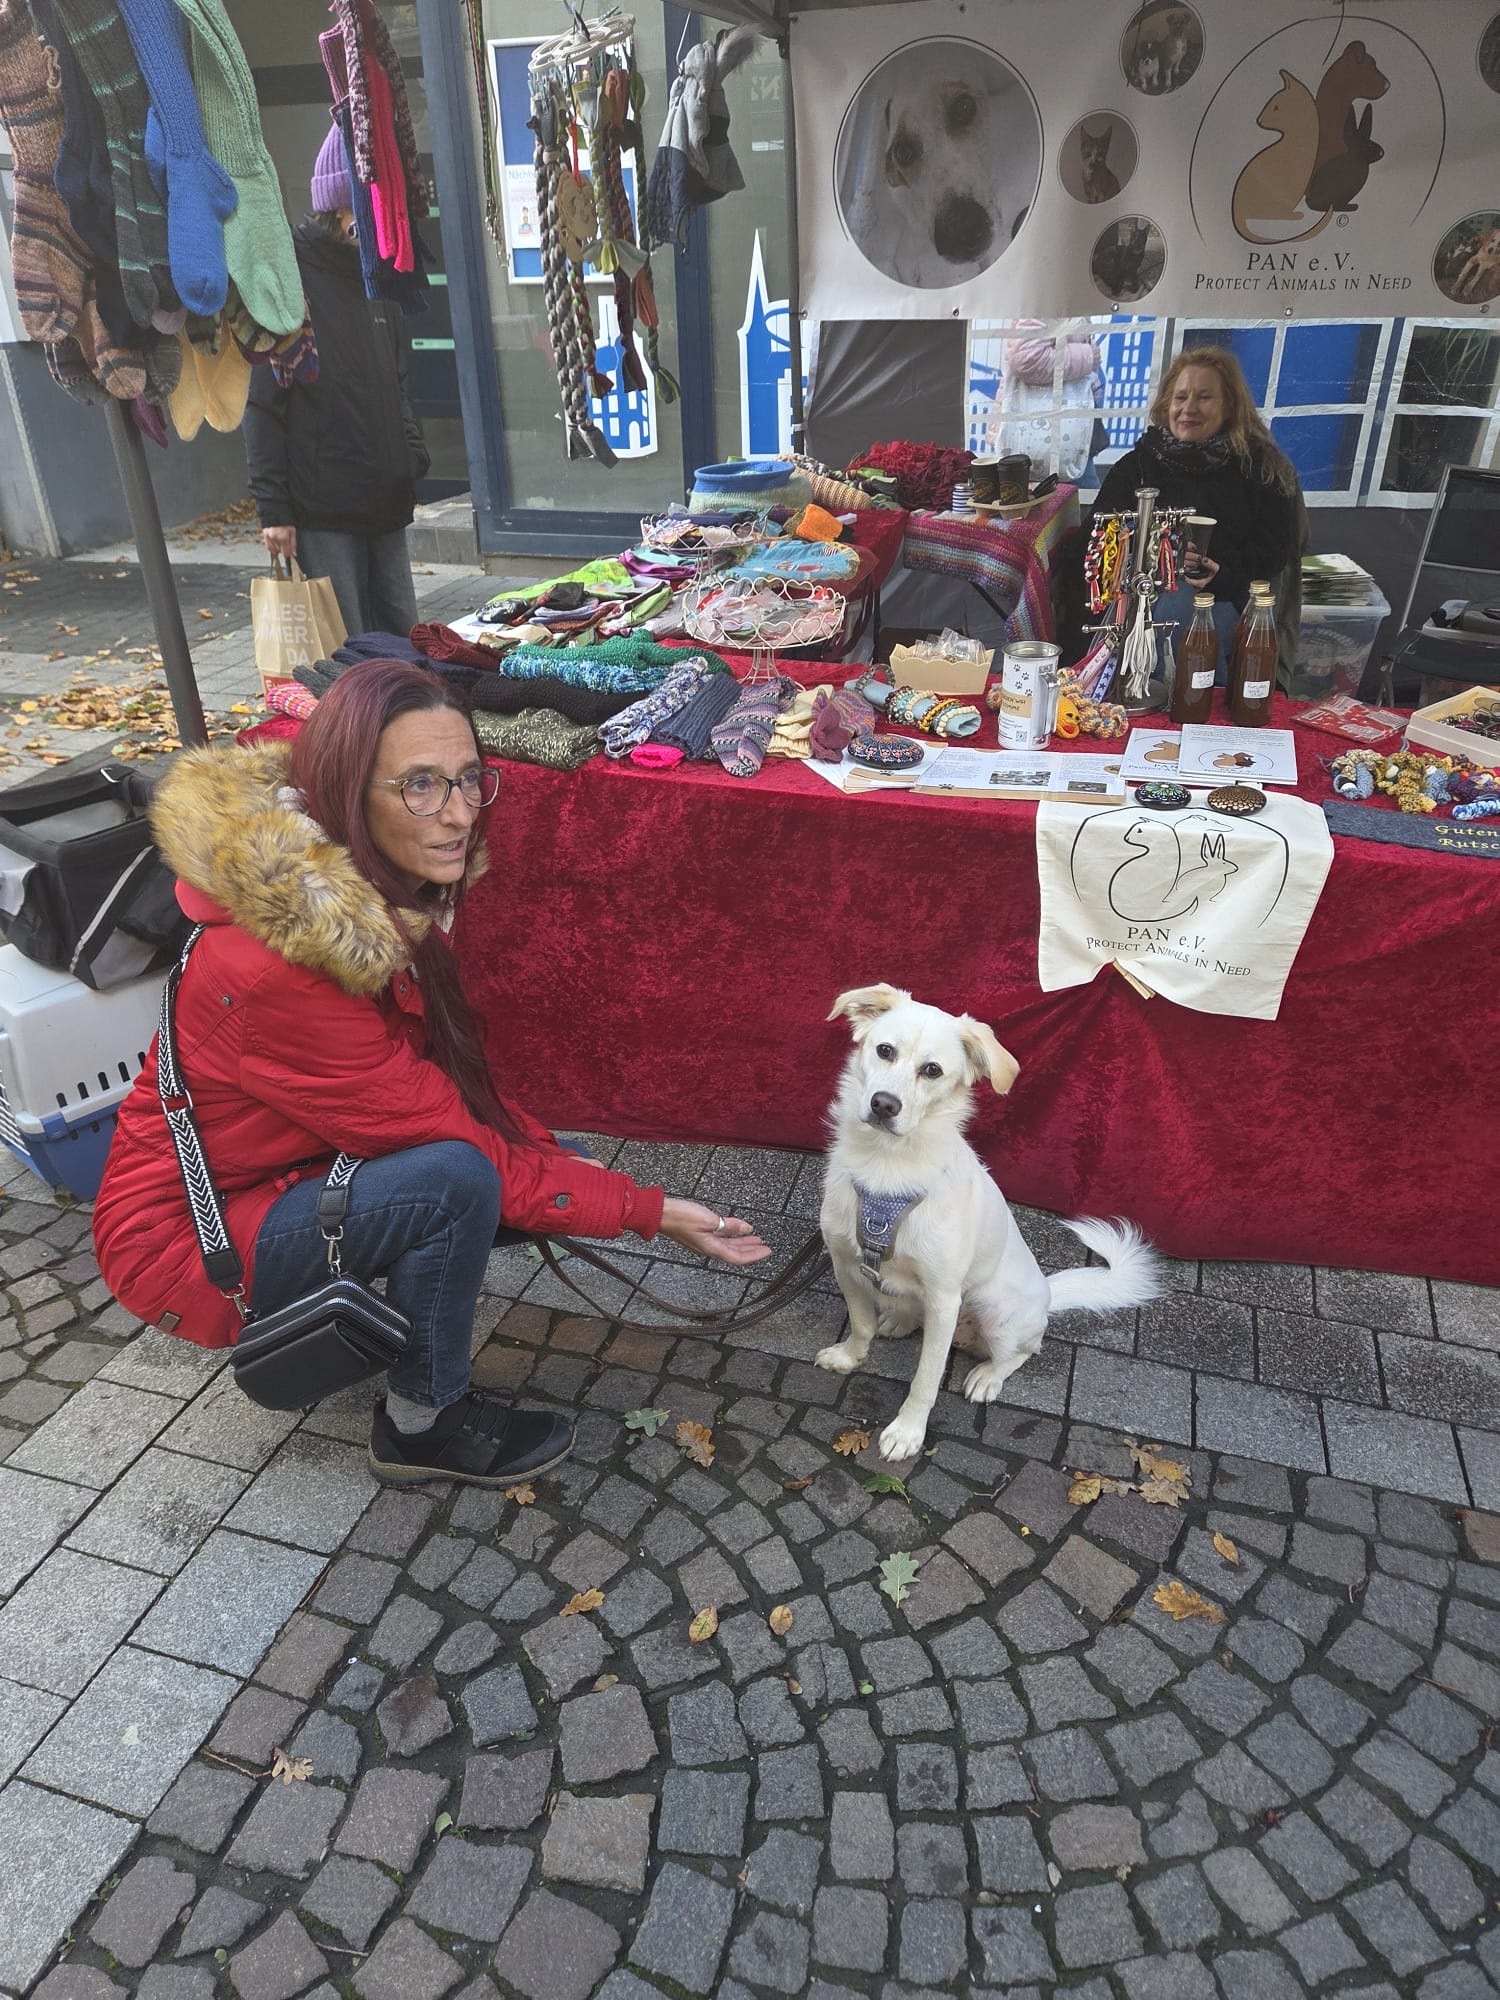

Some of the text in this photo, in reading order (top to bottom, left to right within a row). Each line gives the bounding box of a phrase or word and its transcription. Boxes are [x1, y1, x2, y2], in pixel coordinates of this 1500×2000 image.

[1246, 252, 1298, 271] PAN
[1194, 273, 1412, 291] PROTECT ANIMALS IN NEED
[1435, 825, 1499, 837] Guten
[1127, 926, 1171, 941] PAN
[1086, 936, 1251, 976] PROTECT ANIMALS IN NEED
